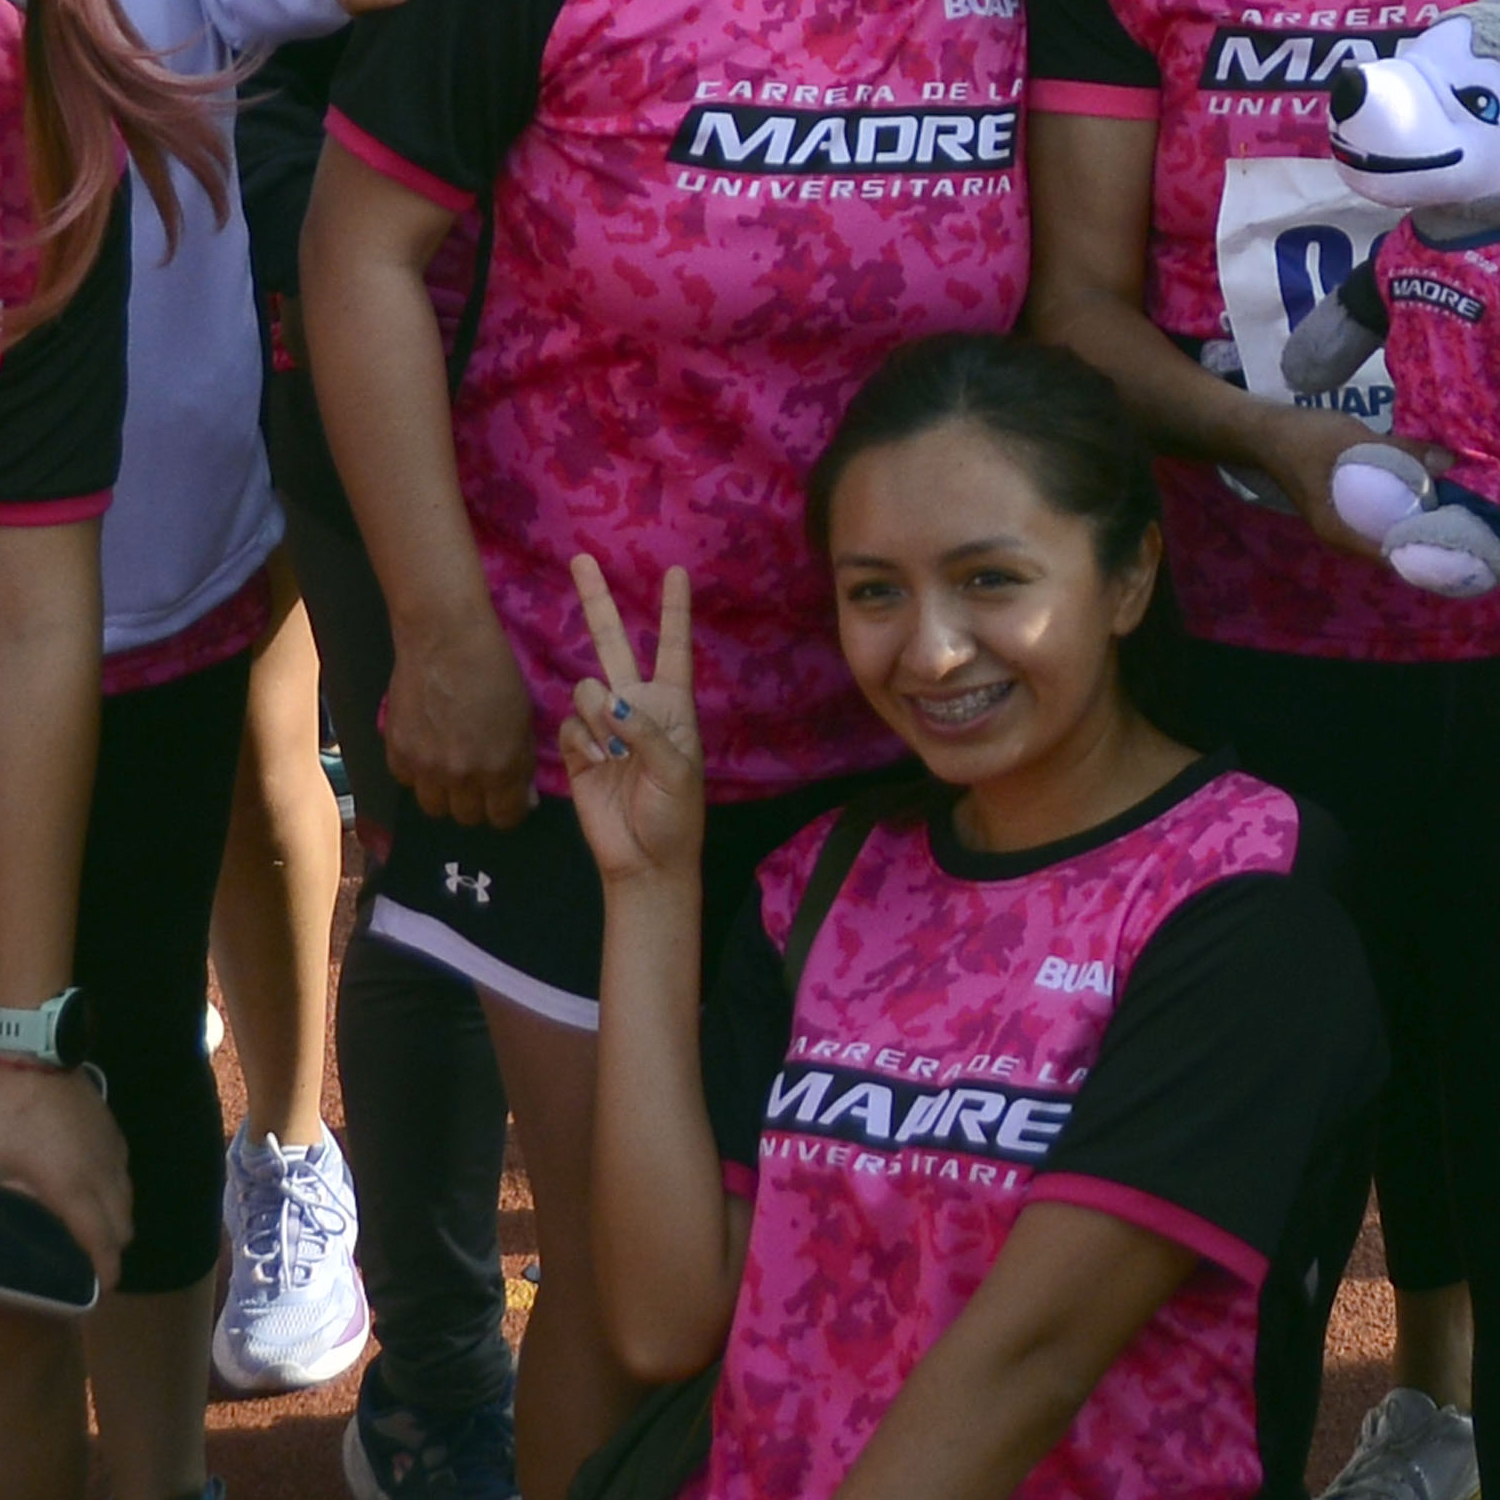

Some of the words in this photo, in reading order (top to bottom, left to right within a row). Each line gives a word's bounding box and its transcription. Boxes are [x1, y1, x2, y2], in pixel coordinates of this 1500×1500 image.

[695, 80, 898, 105] CARRERA
[923, 81, 970, 102] DE
[688, 110, 1017, 166] MADRE
[676, 172, 1015, 200] UNIVERSITARIA
[967, 1052, 1019, 1077] DE
[766, 1071, 1072, 1156] MADRE
